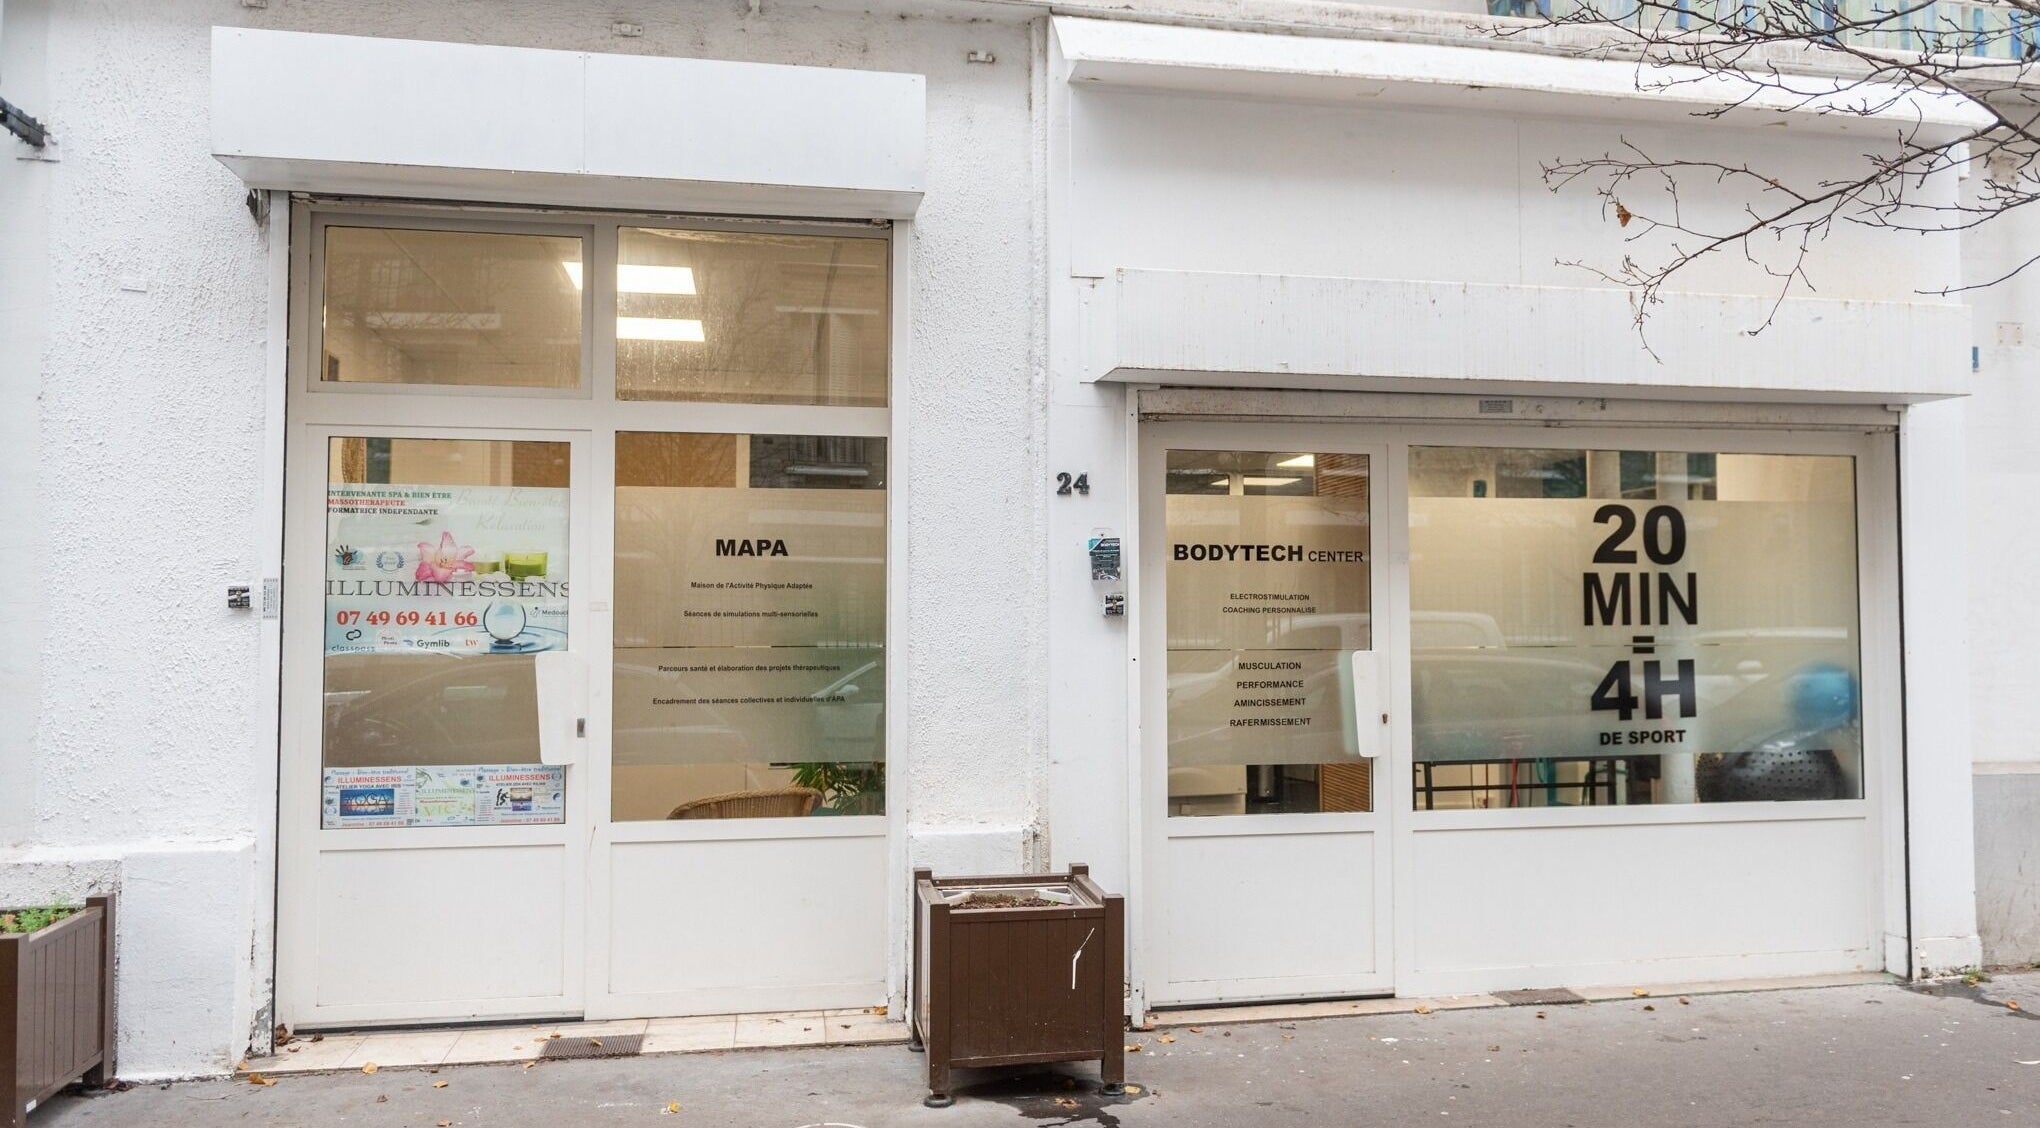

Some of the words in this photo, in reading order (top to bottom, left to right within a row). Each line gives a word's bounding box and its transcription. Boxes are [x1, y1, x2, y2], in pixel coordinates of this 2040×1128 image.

[1056, 471, 1090, 495] 24
[1592, 504, 1686, 565] 20
[715, 539, 789, 557] MAPA
[1174, 544, 1303, 562] BODYTECH
[1308, 551, 1363, 562] CENTER
[327, 580, 568, 598] ILLUMINESSENS
[755, 582, 785, 590] Physique
[786, 582, 813, 590] Adaptée
[1230, 593, 1310, 601] ELECTROSTIMULATION
[1583, 572, 1698, 626] MIN
[337, 611, 361, 625] 07
[366, 611, 390, 625] 49
[396, 611, 420, 625] 69
[425, 611, 447, 625] 41
[454, 611, 478, 626] 66
[416, 640, 450, 649] Gymlib
[768, 665, 791, 673] projets
[792, 665, 841, 673] thérapeutiques
[1238, 662, 1302, 670] MUSCULATION
[1236, 680, 1304, 689] PERFORMANCE
[1591, 659, 1697, 721] 4H
[1234, 698, 1306, 707] AMINCISSEMENT
[1230, 717, 1312, 727] RAFERMISSEMENT
[1600, 731, 1622, 746] DE
[1628, 729, 1686, 745] SPORT
[338, 776, 402, 784] ILLUMINESSENS
[489, 773, 550, 781] ILLUMINESSENS
